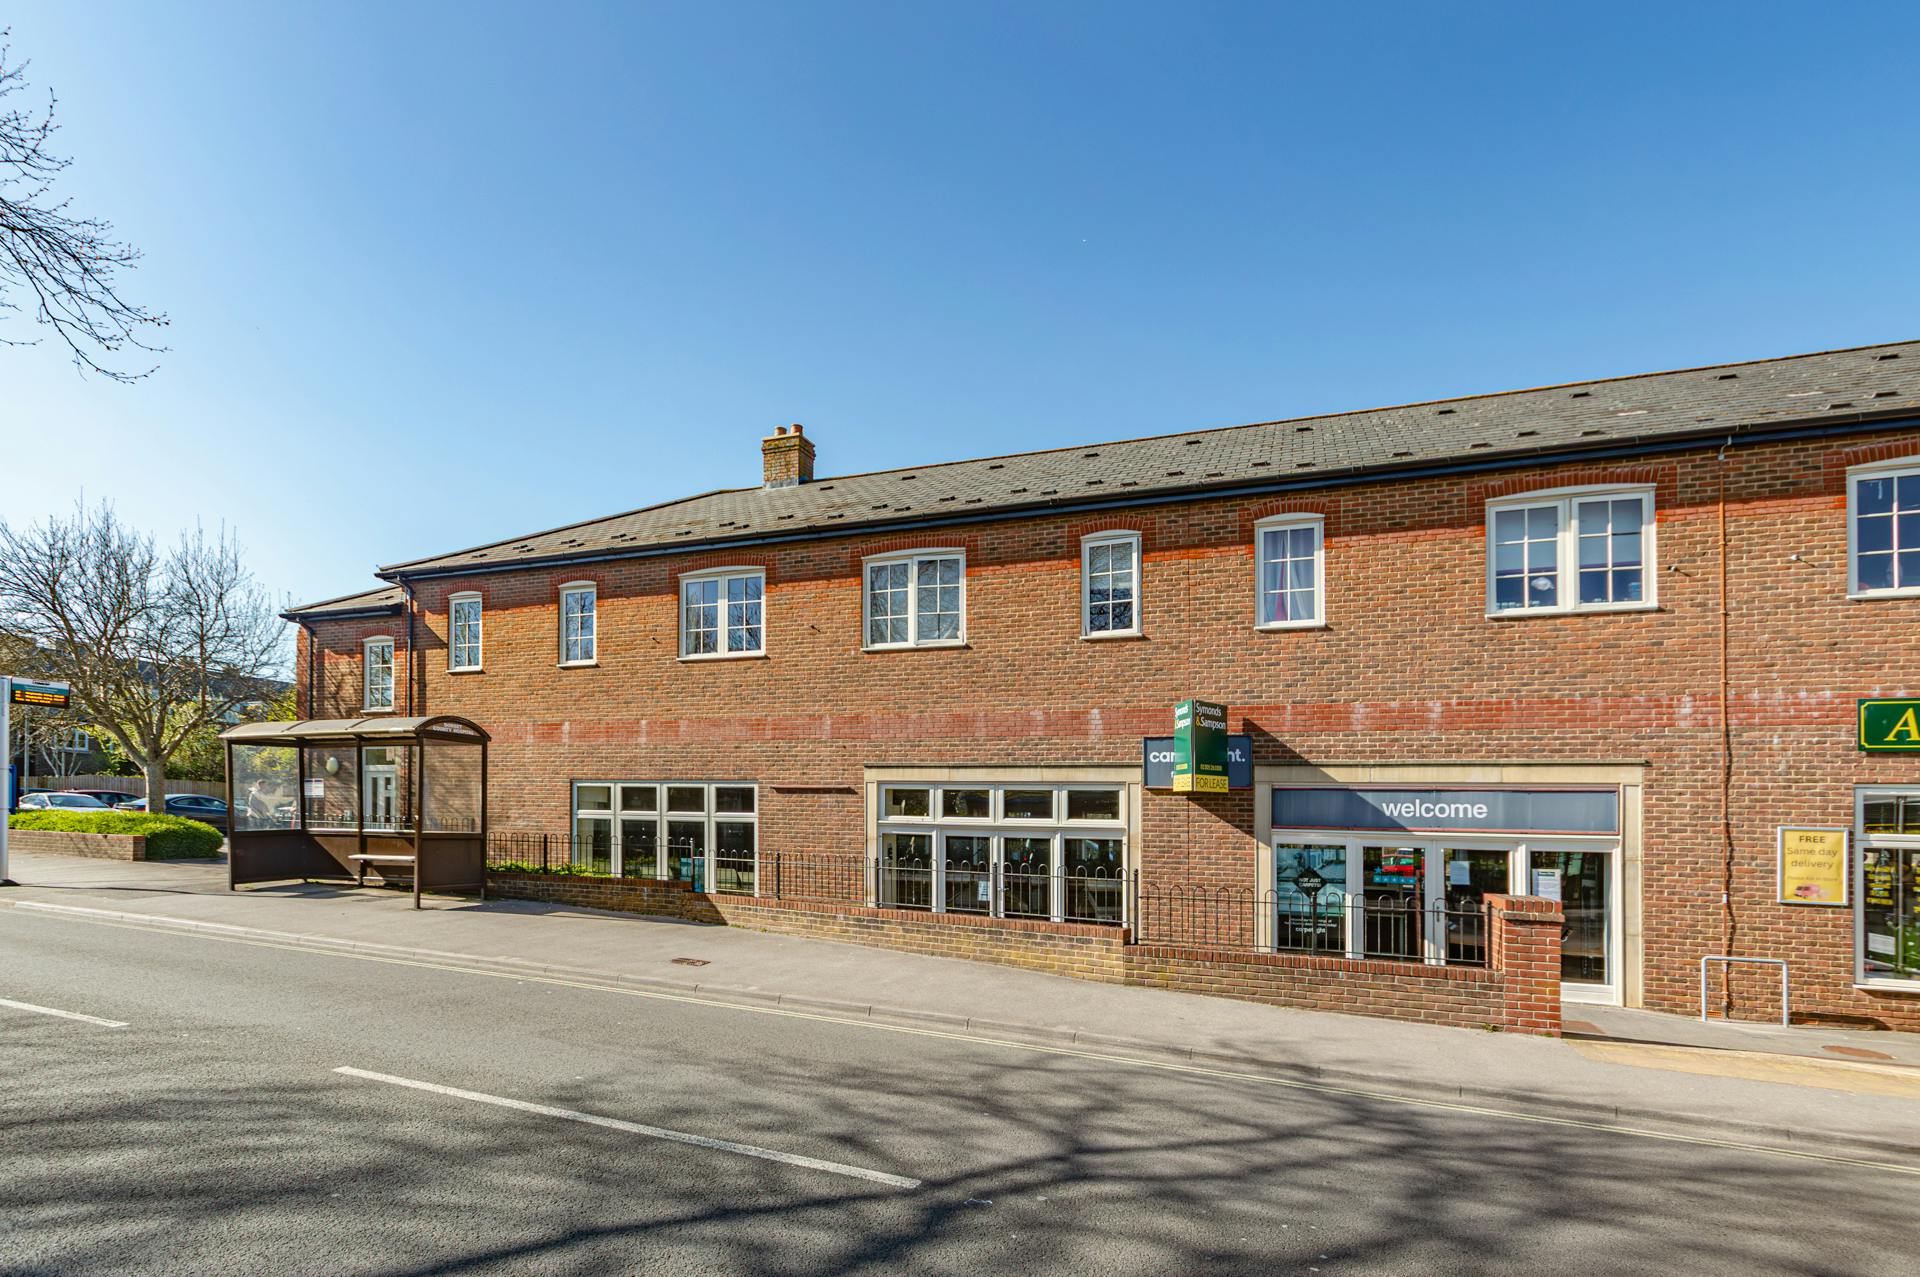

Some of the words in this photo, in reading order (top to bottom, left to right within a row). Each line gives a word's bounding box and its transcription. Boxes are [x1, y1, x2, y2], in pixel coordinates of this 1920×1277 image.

[1195, 702, 1222, 717] Symonds
[1195, 777, 1209, 788] FOR
[1209, 778, 1227, 789] LEASE
[1382, 798, 1488, 819] welcome
[1799, 835, 1826, 844] FREE
[1787, 847, 1816, 856] Same
[1818, 847, 1838, 857] day
[1791, 859, 1834, 870] delivery
